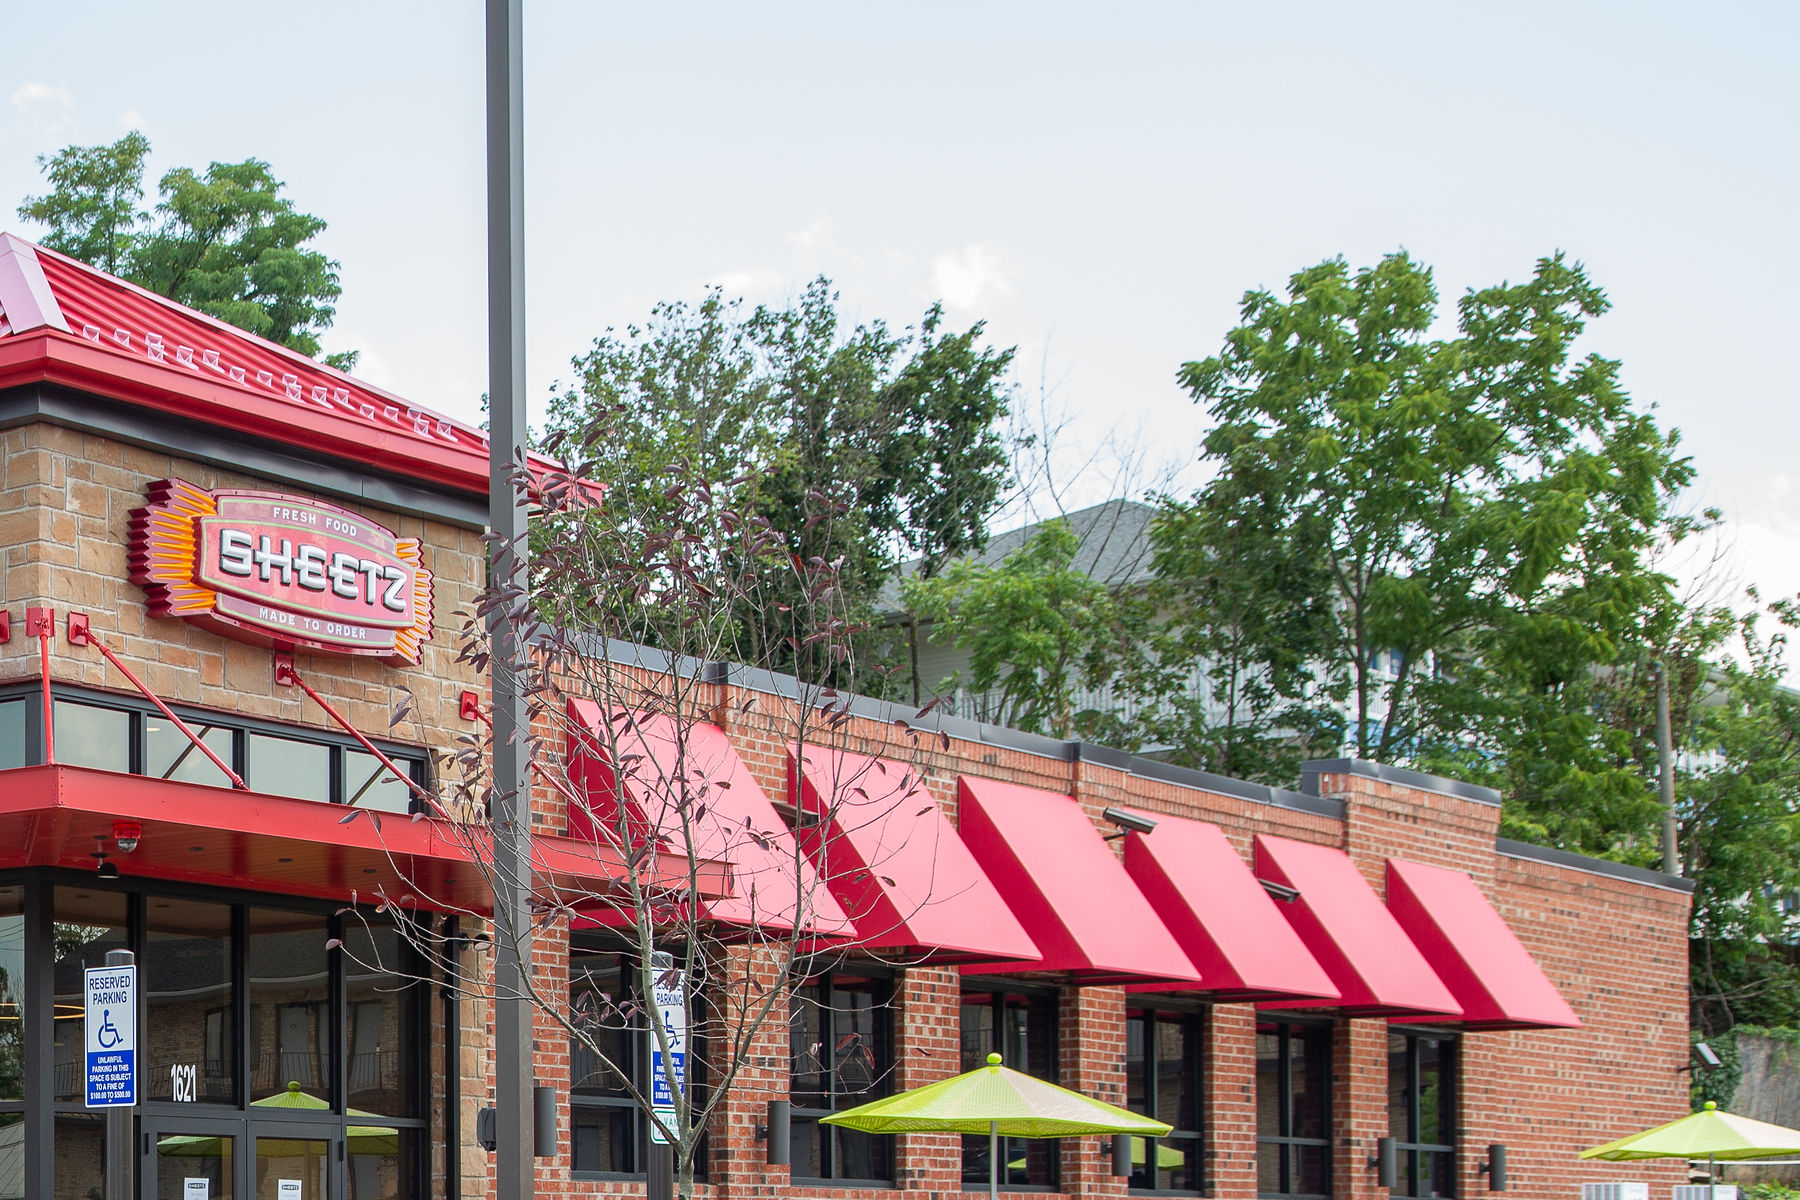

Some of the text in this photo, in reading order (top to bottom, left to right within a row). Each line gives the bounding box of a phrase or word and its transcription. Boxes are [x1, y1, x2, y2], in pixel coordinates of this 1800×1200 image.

[272, 506, 358, 537] FRESH FOOD
[218, 527, 408, 613] SHEETZ
[258, 606, 367, 641] MADE TO ORDER
[89, 975, 131, 990] RESERVED
[92, 990, 128, 1005] PARKING
[656, 992, 683, 1006] PARKING
[97, 1055, 123, 1064] UNLAWFUL
[91, 1065, 112, 1073] PARKING
[119, 1064, 129, 1072] THIS
[89, 1073, 132, 1082] SPACE IS SUBJECT
[170, 1063, 197, 1102] 1621
[96, 1083, 103, 1091] TO
[118, 1082, 126, 1090] OF
